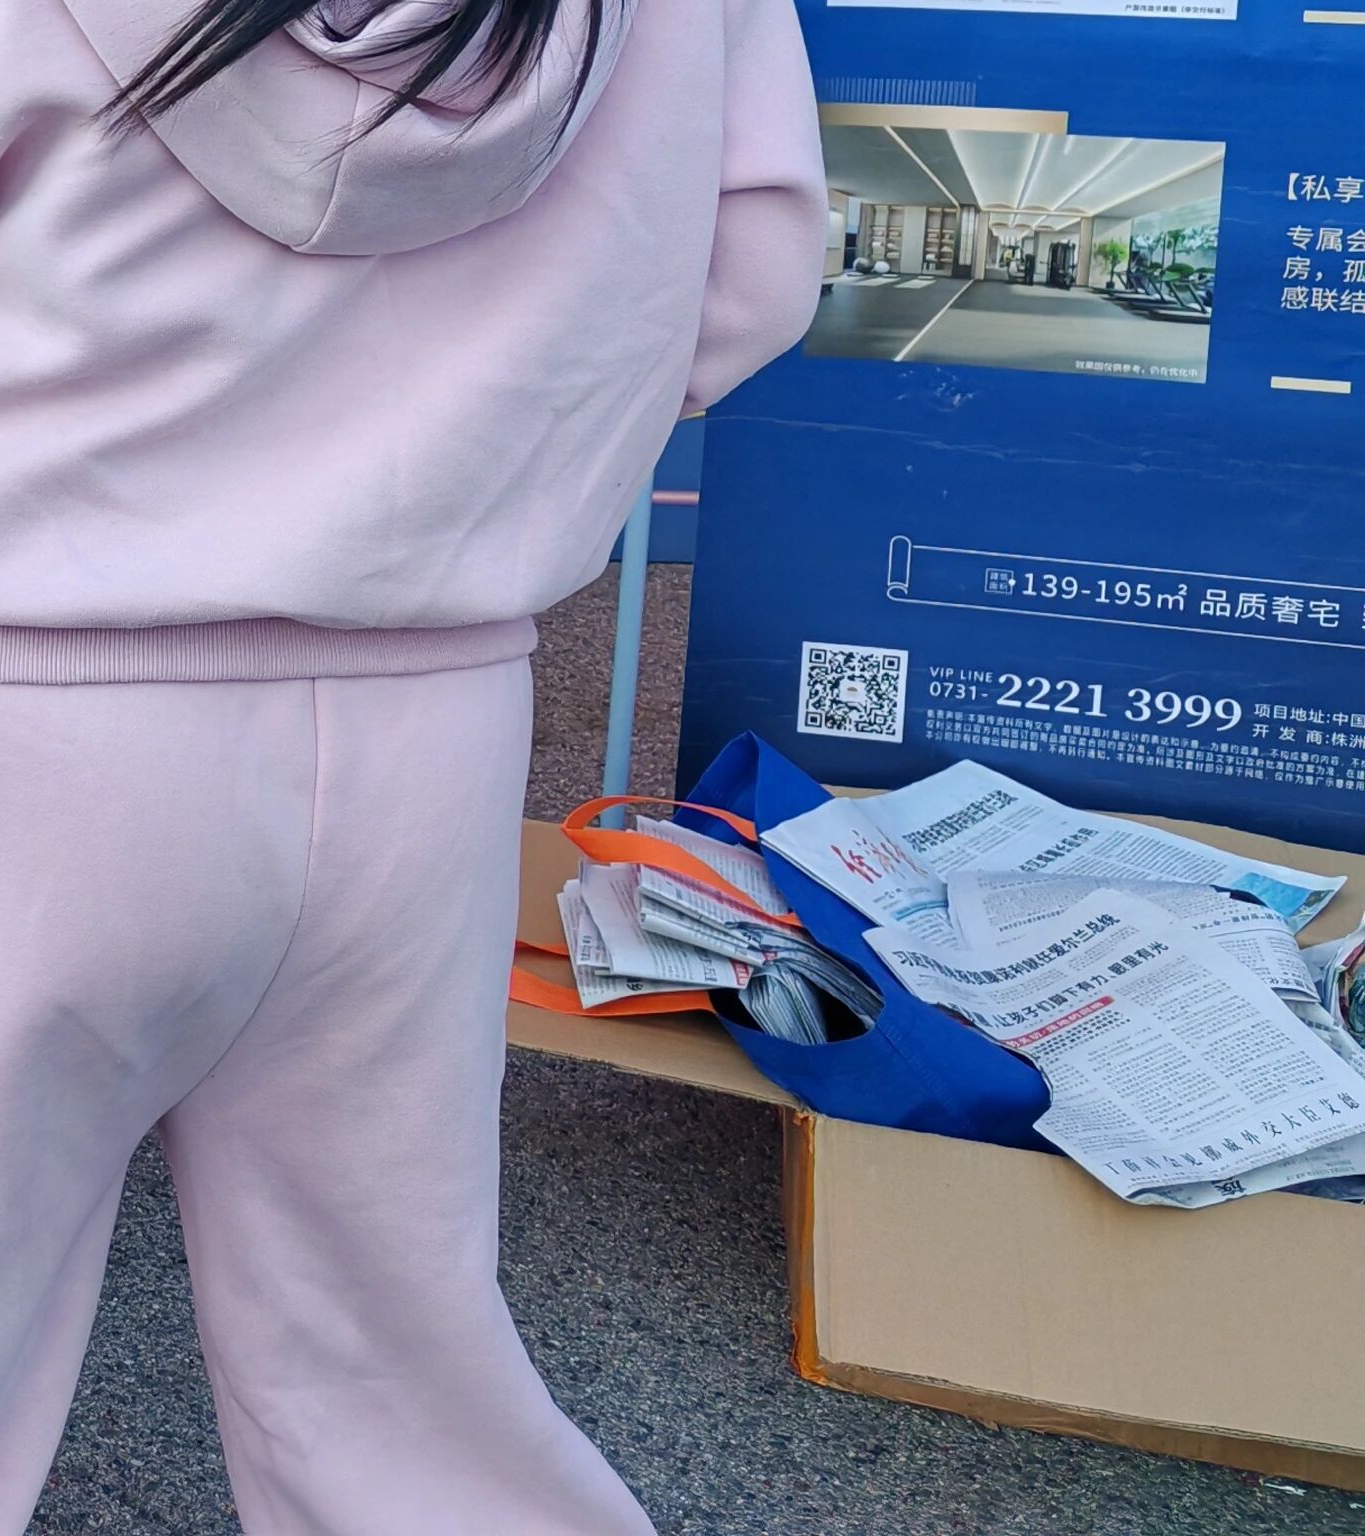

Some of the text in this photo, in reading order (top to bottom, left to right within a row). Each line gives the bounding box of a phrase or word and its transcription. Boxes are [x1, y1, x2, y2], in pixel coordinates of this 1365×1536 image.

[1199, 588, 1340, 628] 品质奢宅
[929, 666, 994, 684] VIP LINE
[996, 672, 1108, 718] 2221
[1123, 687, 1243, 732] 3999
